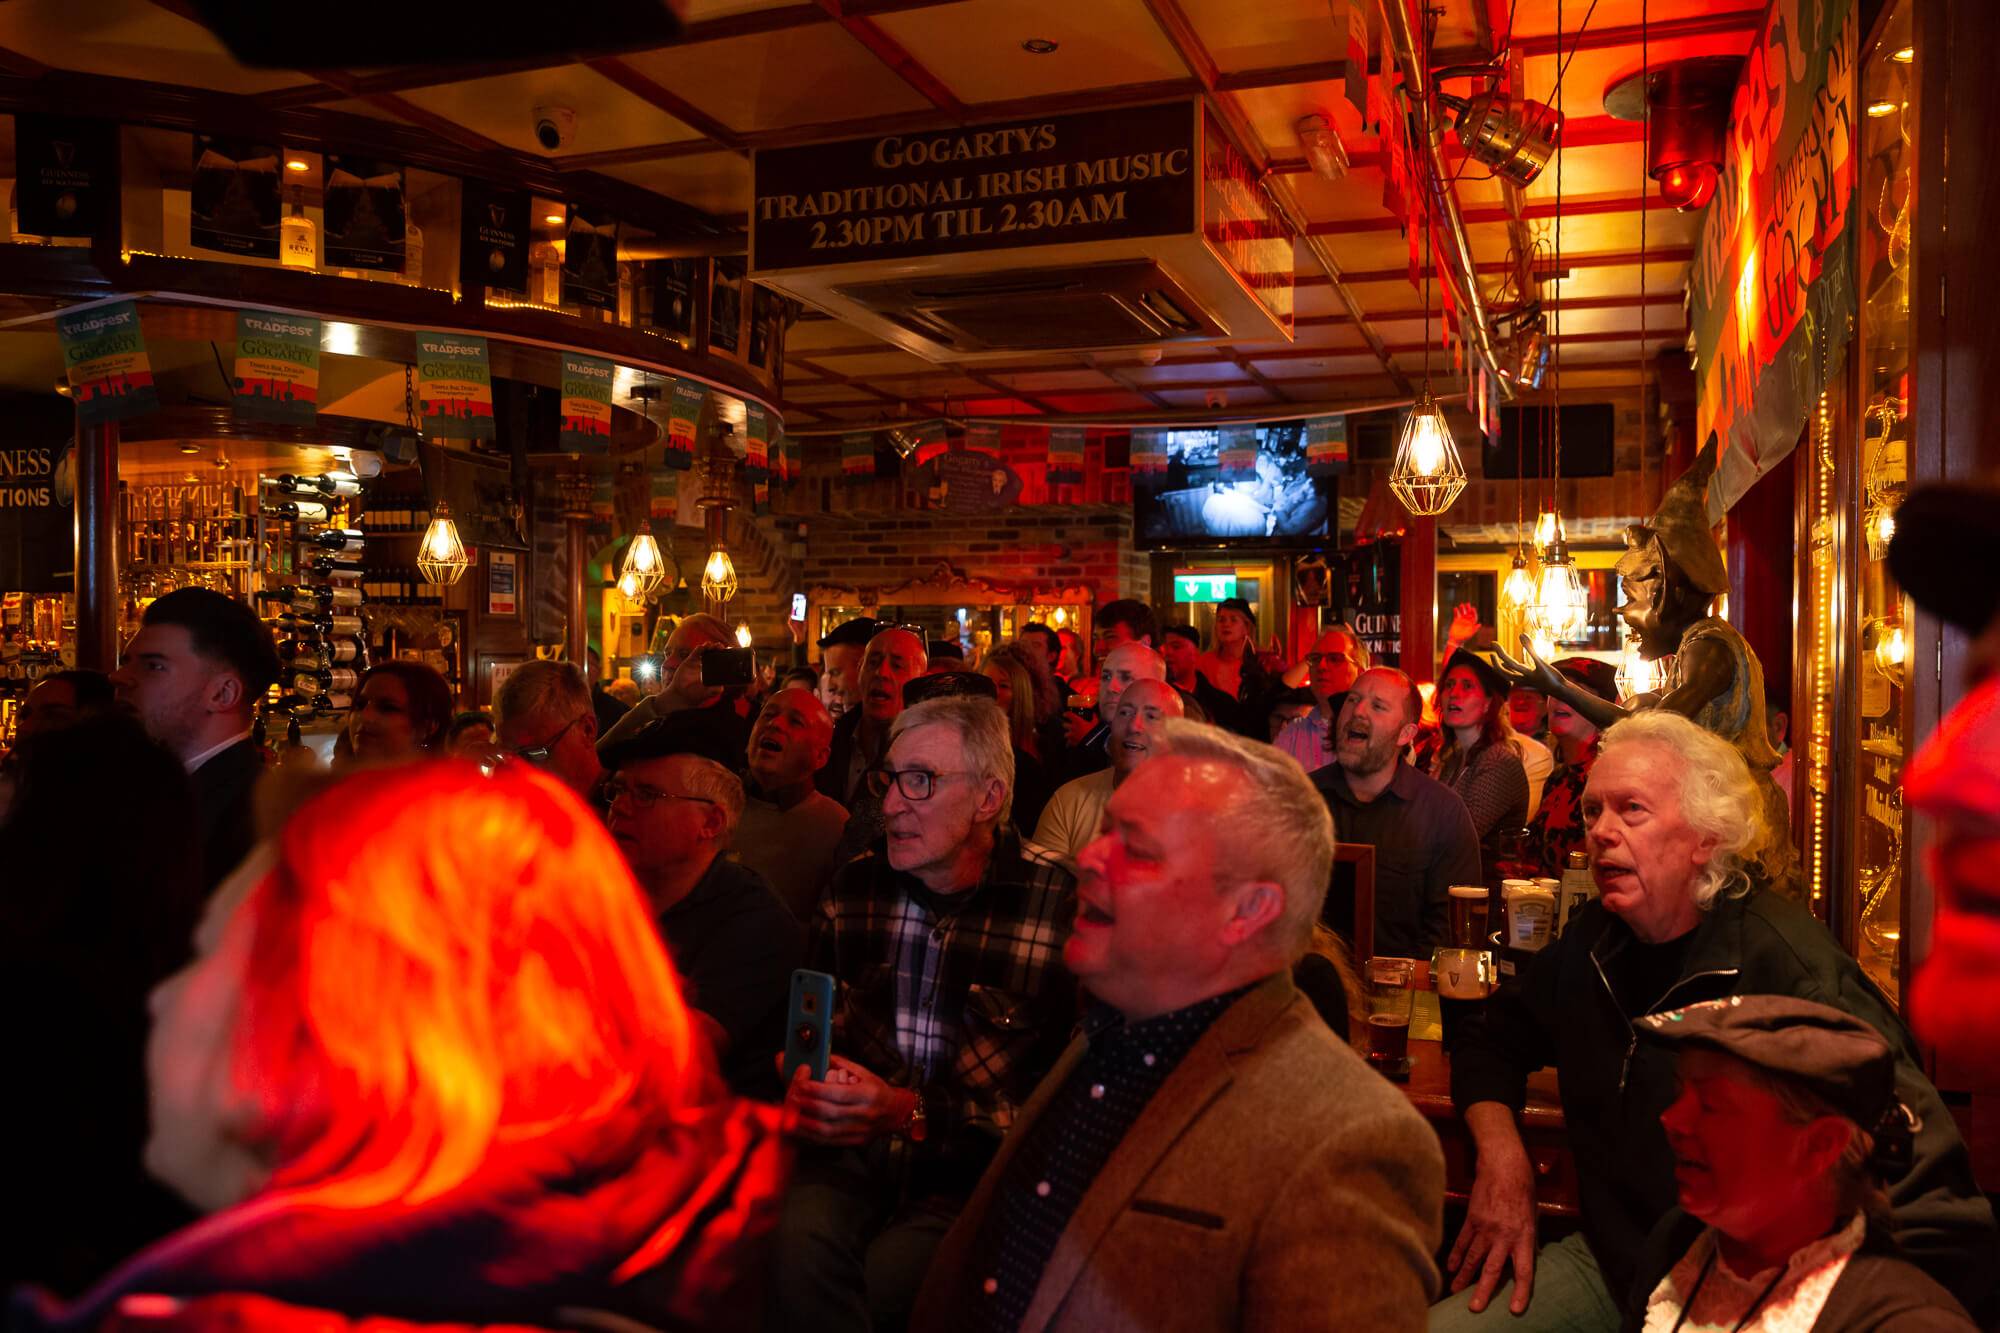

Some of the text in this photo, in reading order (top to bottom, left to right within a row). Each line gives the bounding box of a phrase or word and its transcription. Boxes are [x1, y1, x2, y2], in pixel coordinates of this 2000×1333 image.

[873, 124, 1057, 169] GOGARTYS
[759, 148, 1190, 221] TRADITIONAL IRISH MUSIC
[809, 191, 1128, 249] 2.30PM TIL 2.30AM
